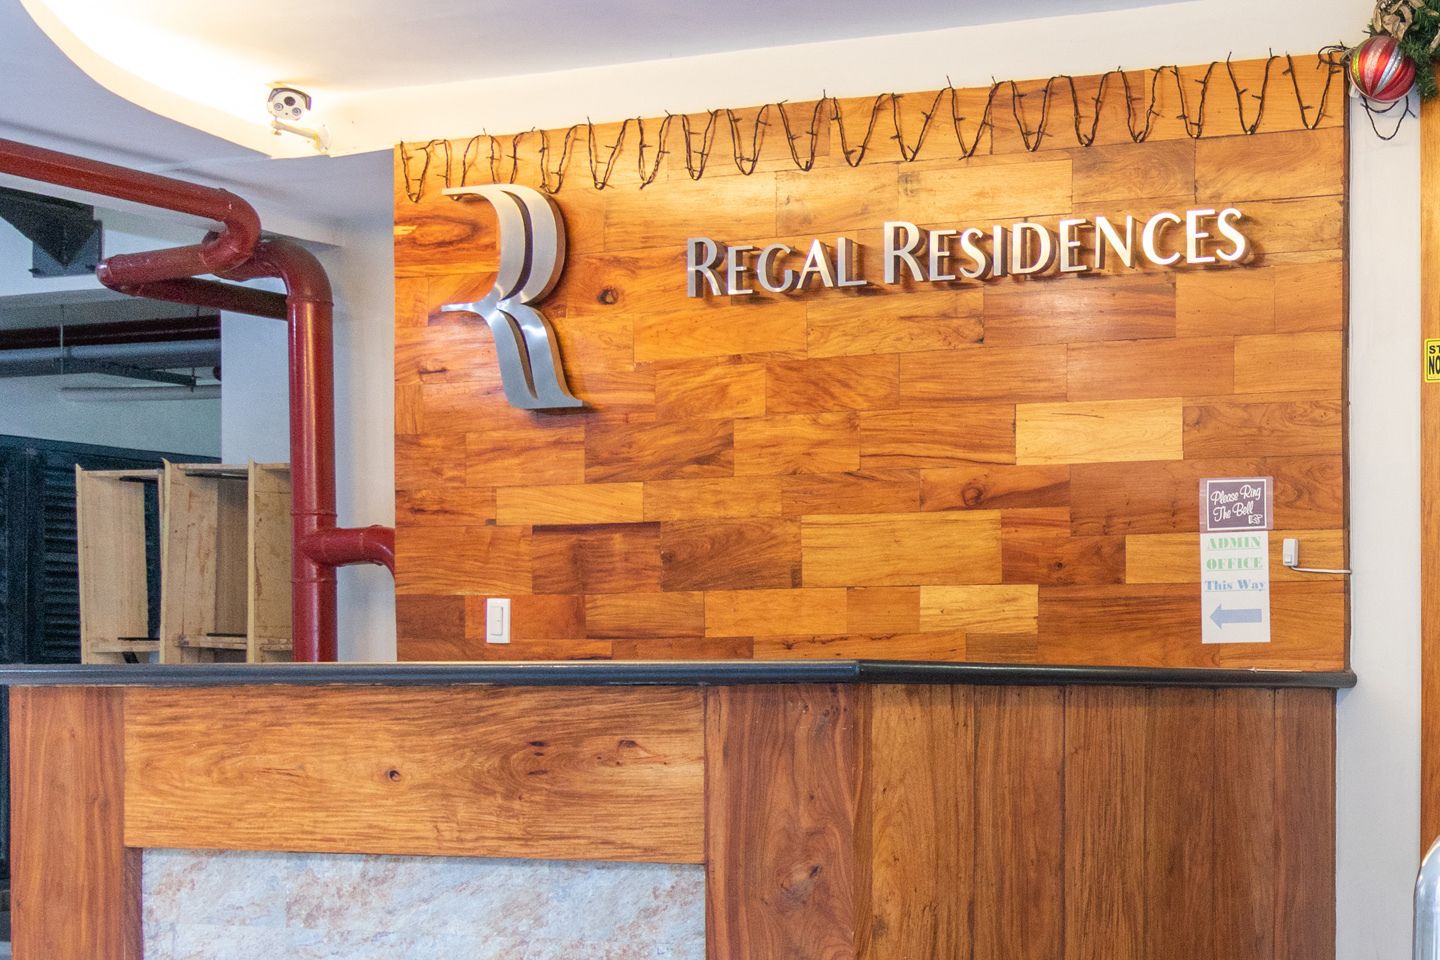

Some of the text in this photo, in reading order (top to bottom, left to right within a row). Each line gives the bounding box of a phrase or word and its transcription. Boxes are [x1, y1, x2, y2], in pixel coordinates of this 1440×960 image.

[687, 207, 1247, 299] REGAL RESIDENCES
[1210, 484, 1261, 505] Please Ring
[1213, 501, 1254, 522] The Bell
[1208, 536, 1261, 549] ADMIN
[1206, 557, 1263, 570] OFFICE
[1205, 579, 1264, 592] This Way
